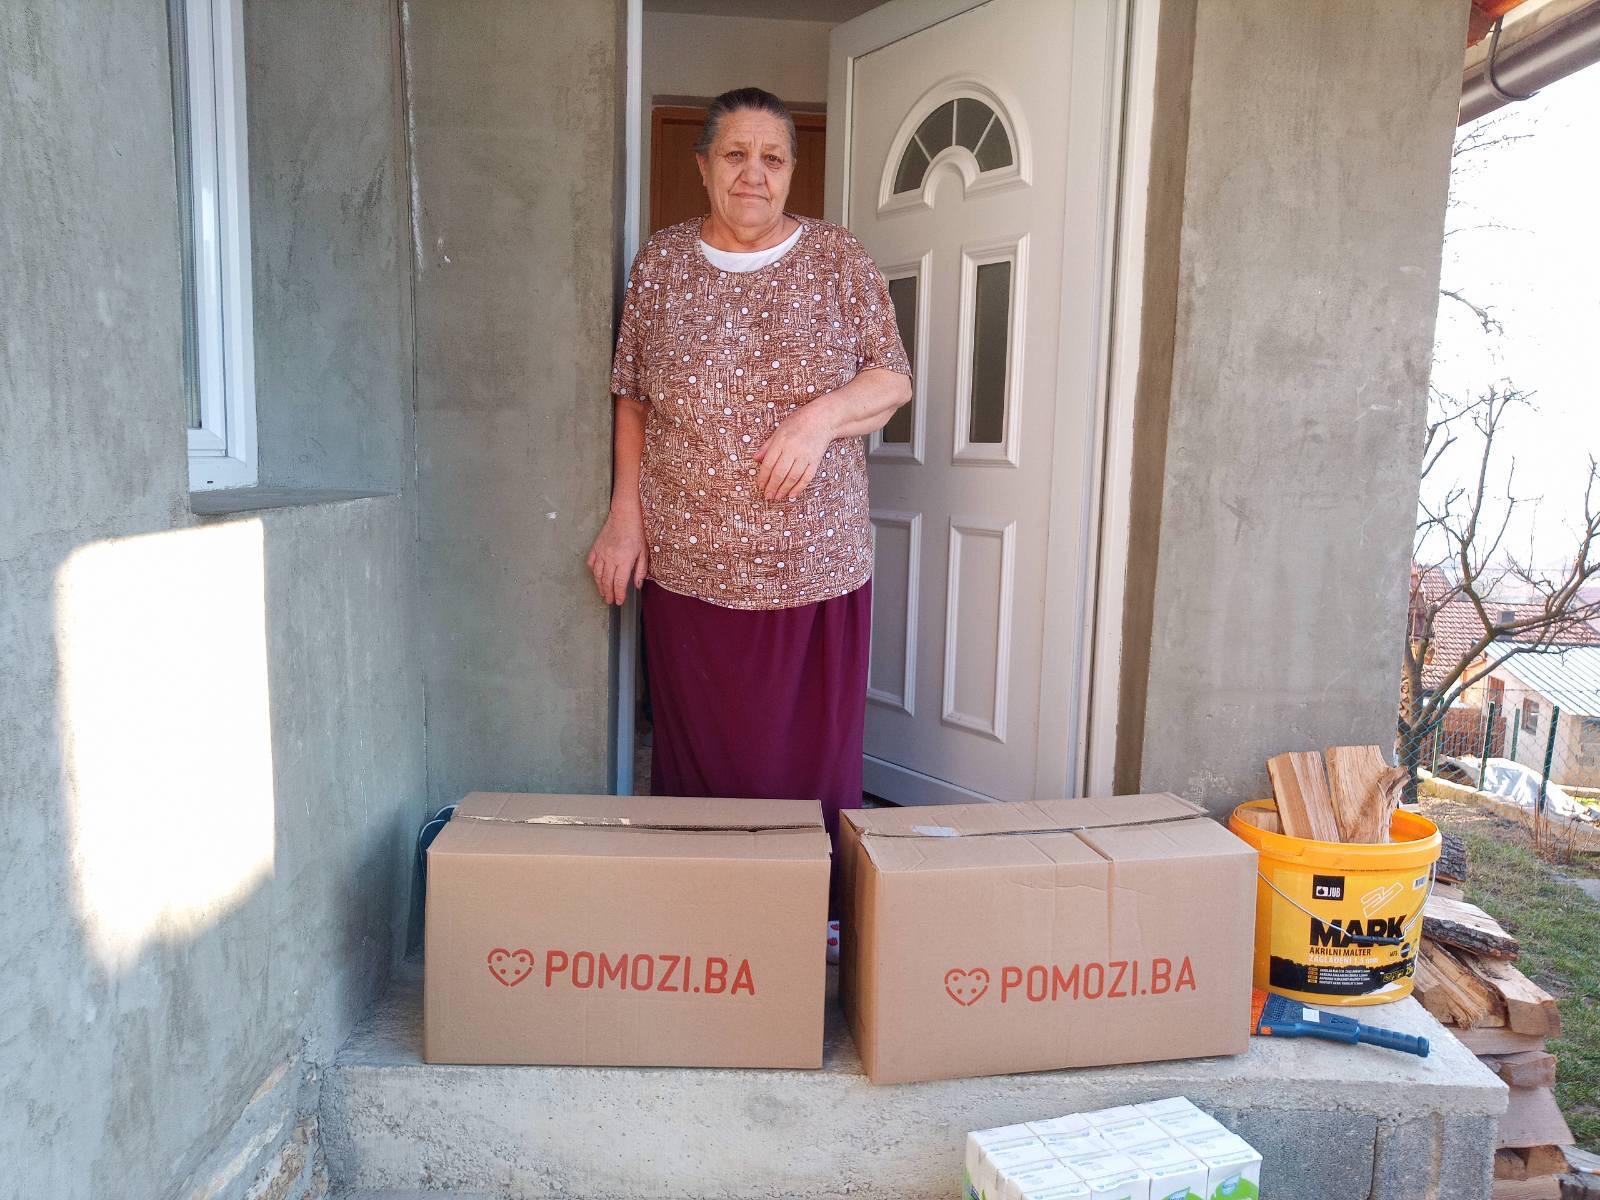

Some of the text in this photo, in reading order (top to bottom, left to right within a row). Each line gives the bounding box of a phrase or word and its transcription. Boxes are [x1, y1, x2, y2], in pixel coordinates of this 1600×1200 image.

[1328, 887, 1341, 898] JUB
[1309, 914, 1407, 948] MARK
[1309, 946, 1371, 957] AKRILNI MALTER
[545, 950, 755, 996] POMOZI.BA
[1001, 956, 1196, 1004] POMOZI.BA
